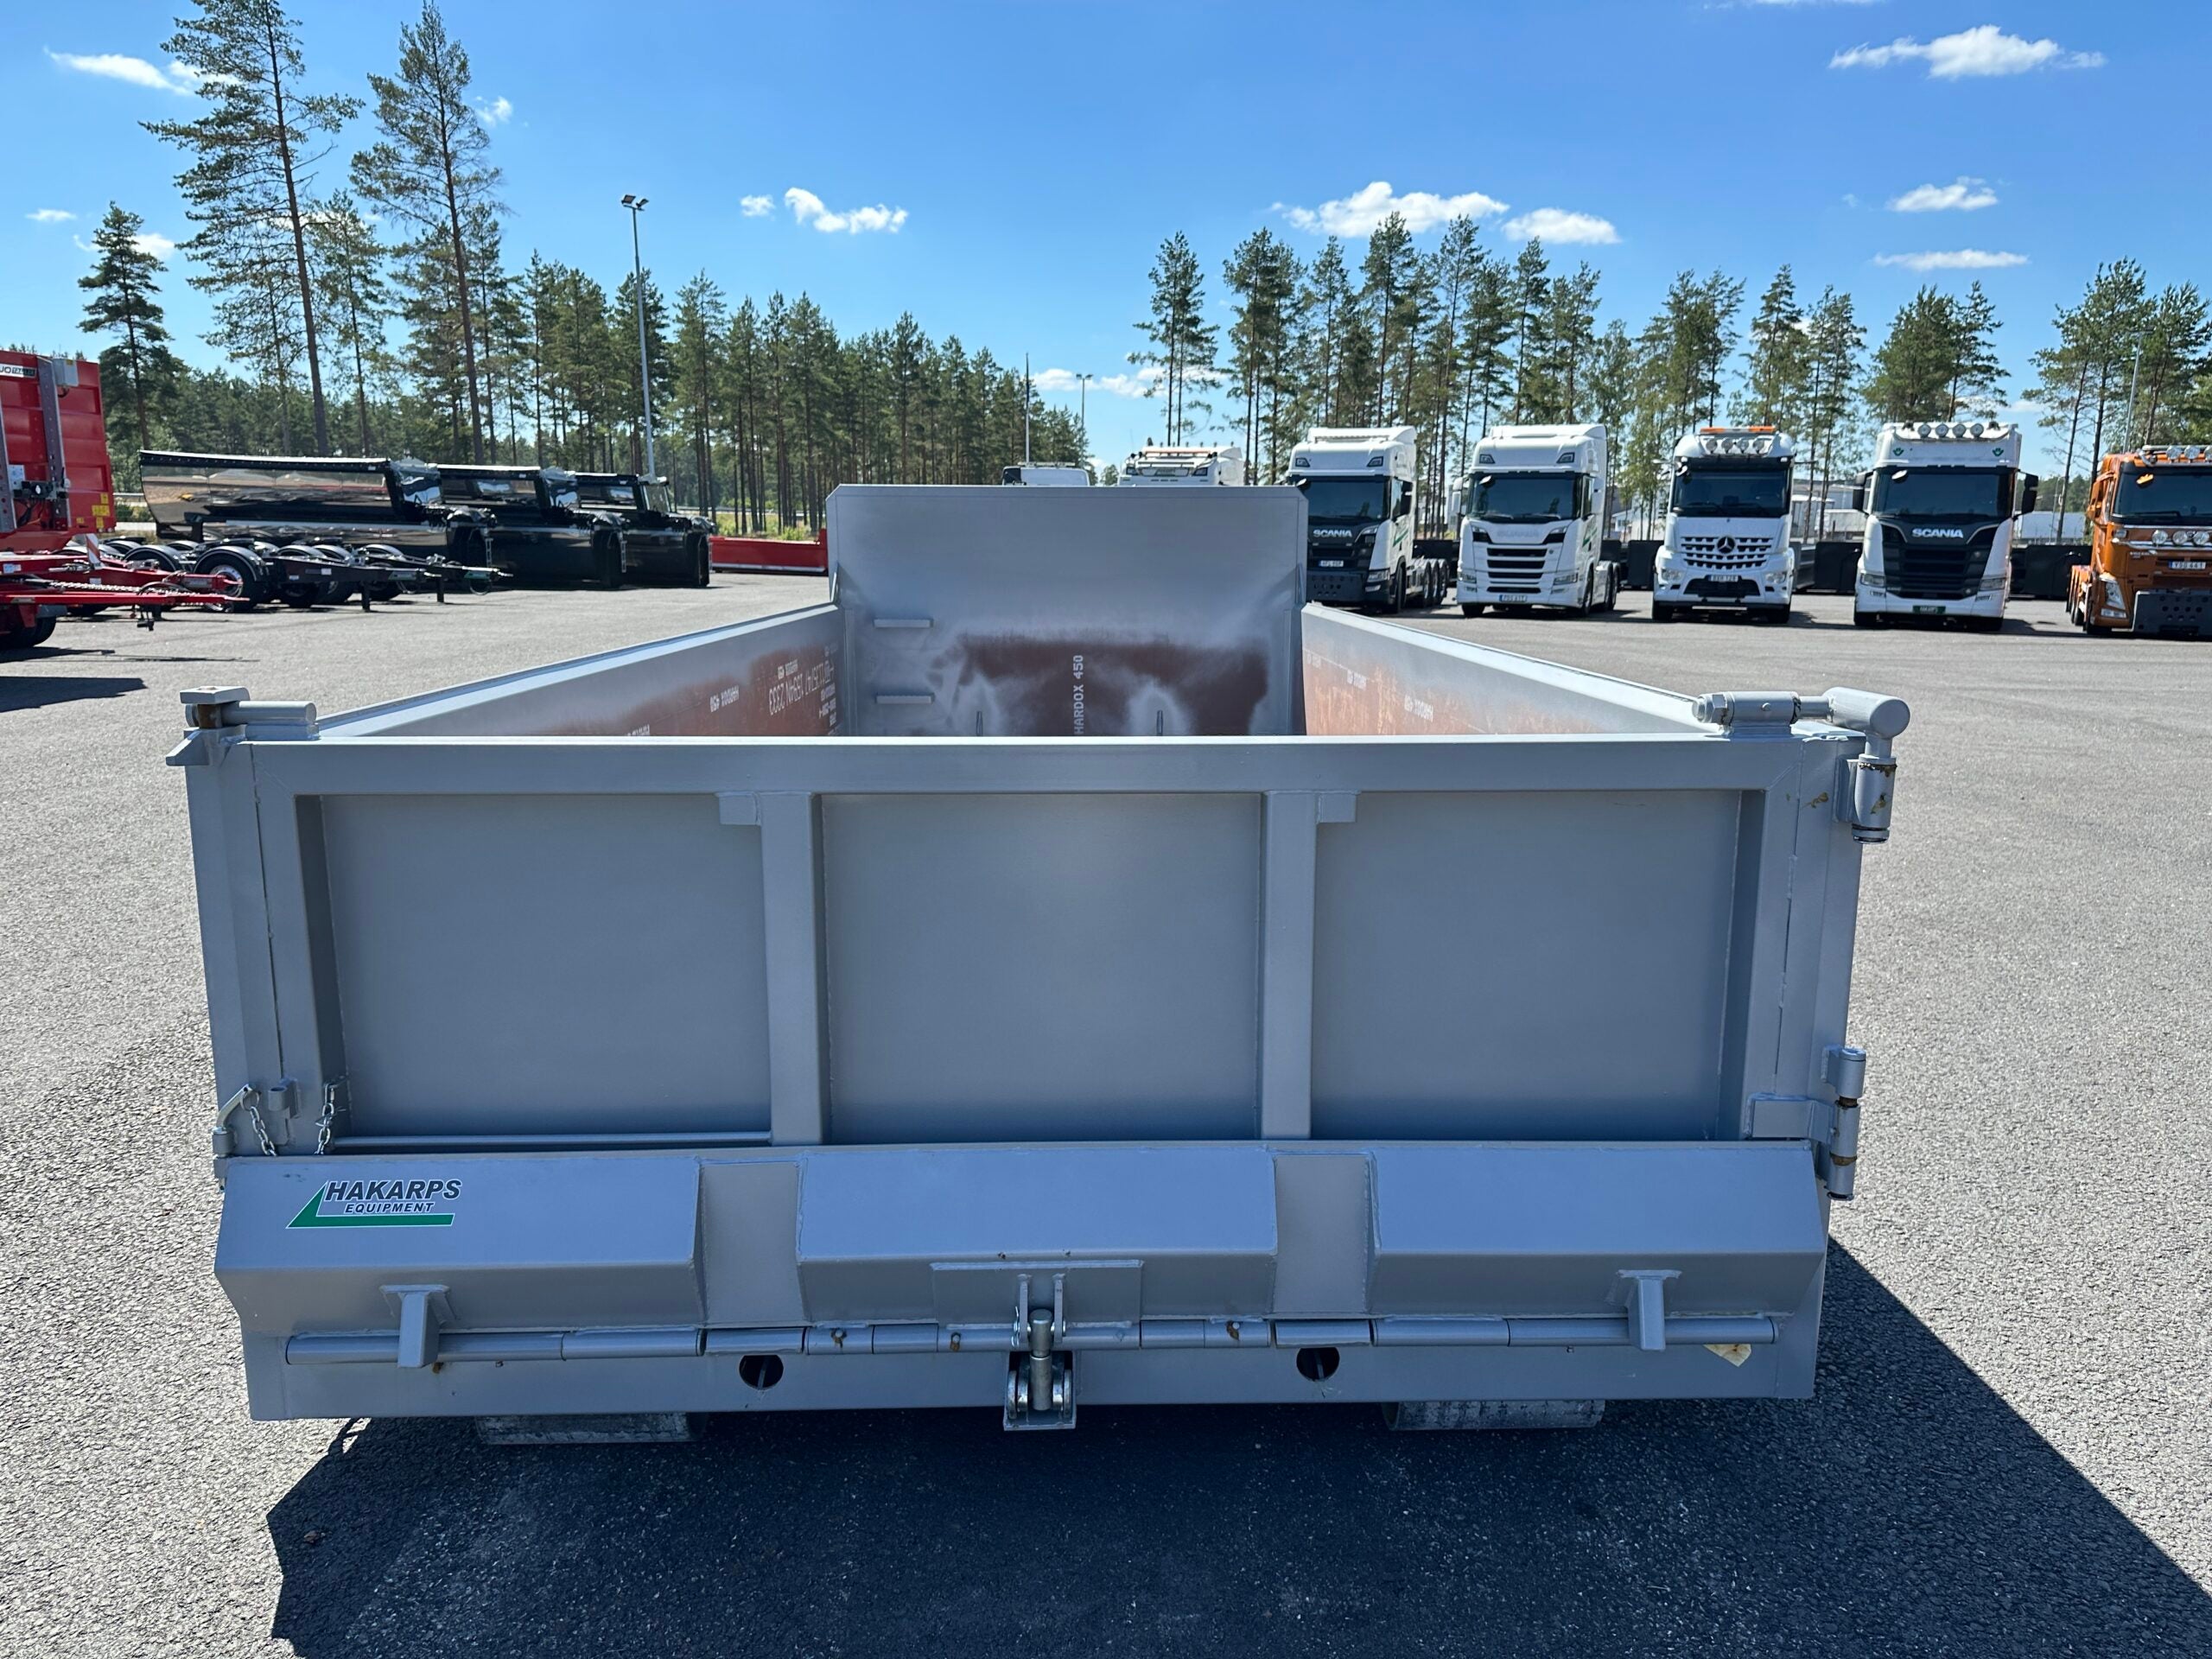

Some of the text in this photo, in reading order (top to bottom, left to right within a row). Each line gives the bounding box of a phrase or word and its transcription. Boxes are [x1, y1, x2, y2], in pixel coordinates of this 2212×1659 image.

[1313, 529, 1352, 538] SCANIA
[1912, 528, 1964, 538] SCANIA
[1073, 655, 1084, 734] HARDOX 450
[325, 1179, 461, 1201] HAKARPS
[345, 1203, 434, 1214] EQUIPMENT
